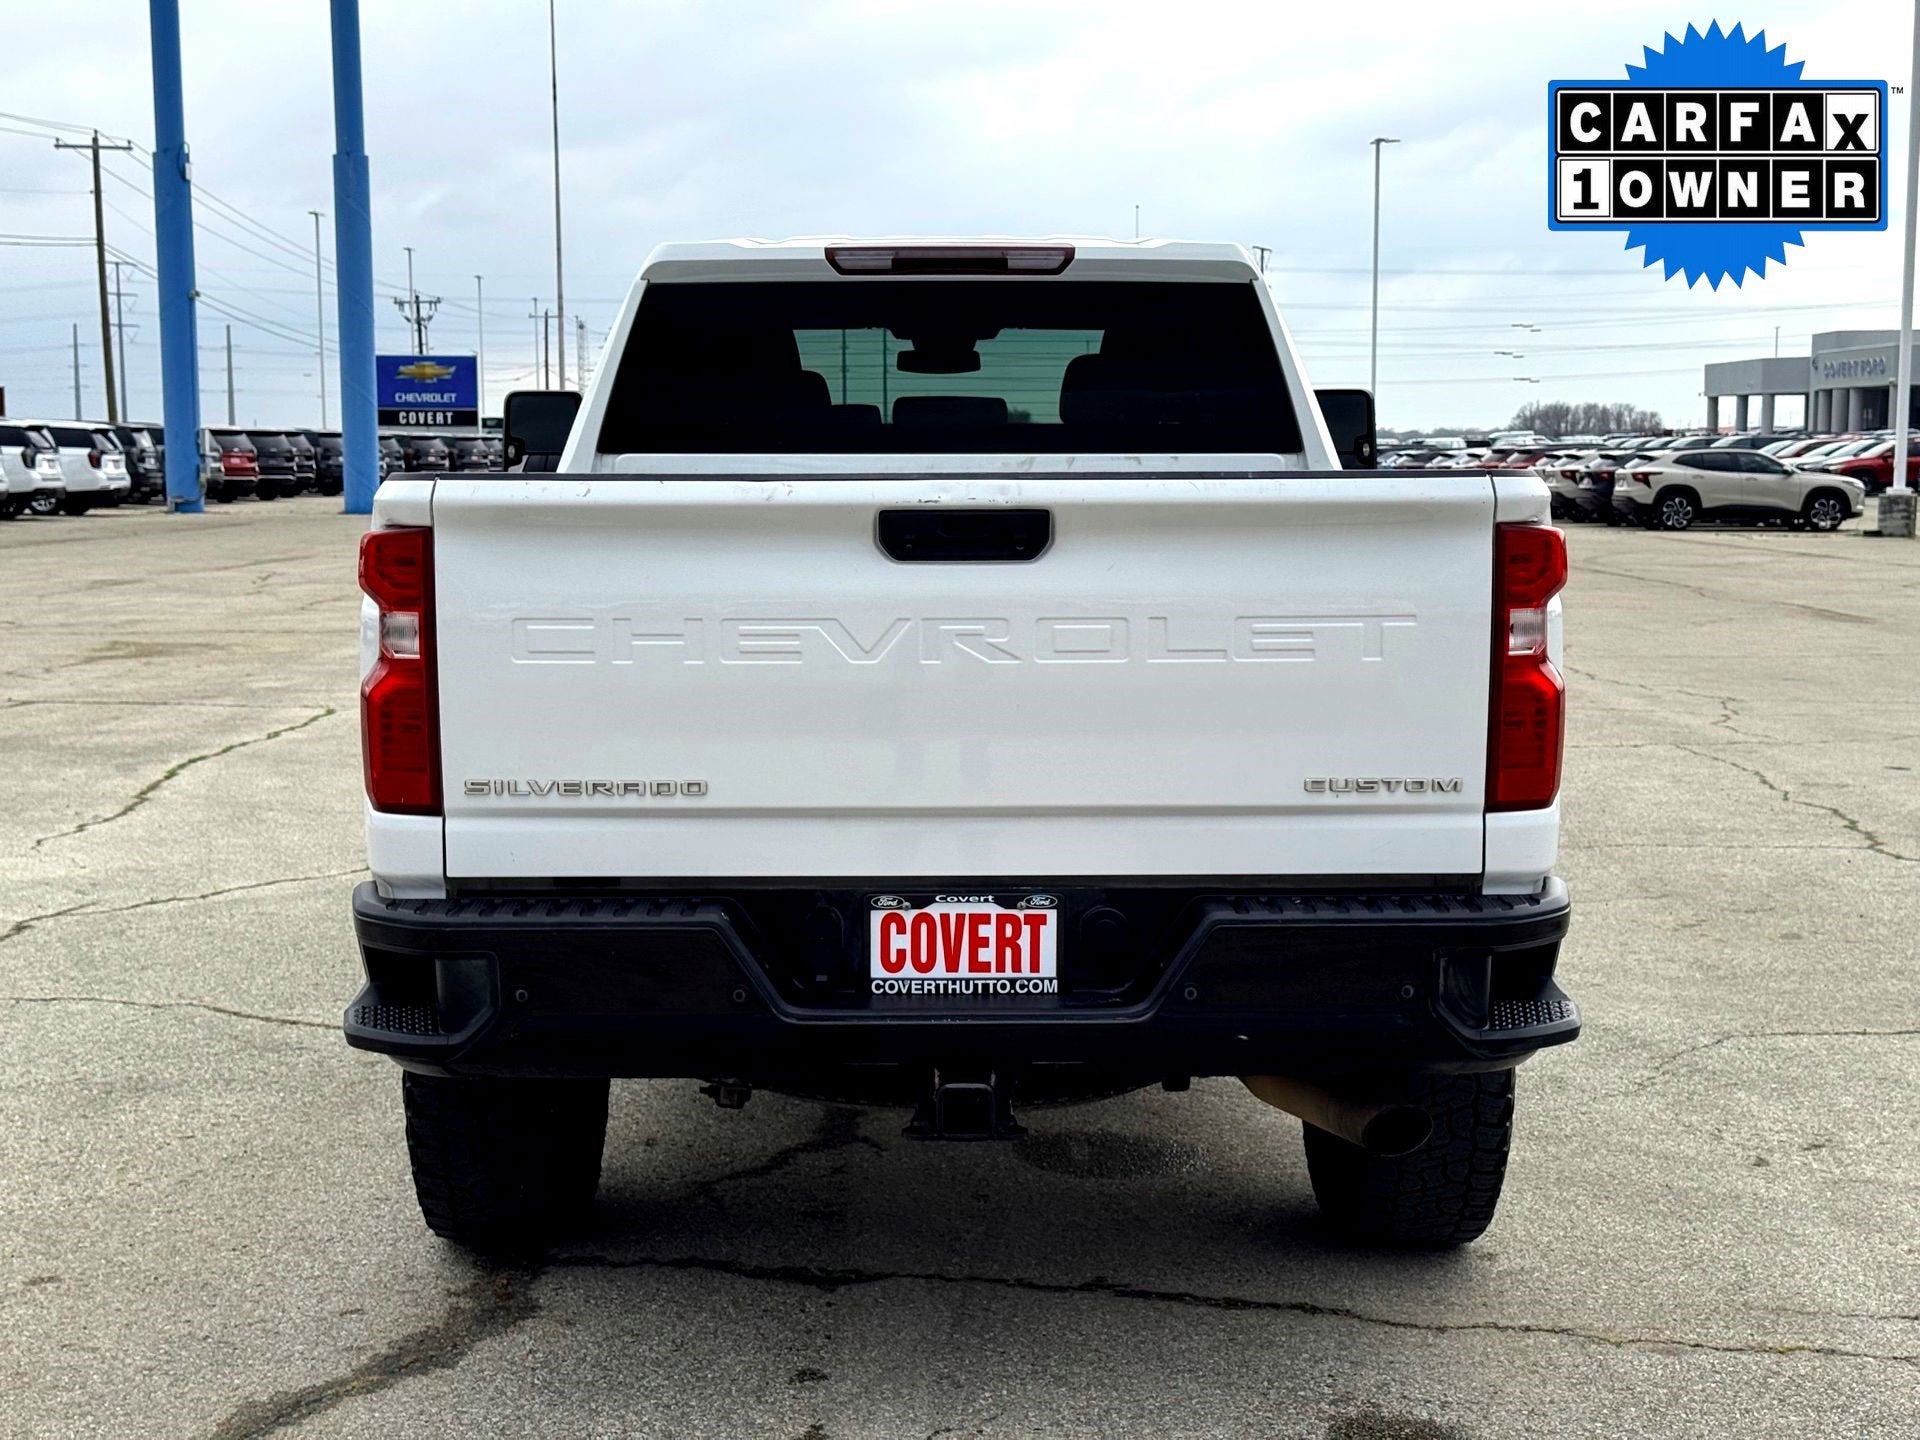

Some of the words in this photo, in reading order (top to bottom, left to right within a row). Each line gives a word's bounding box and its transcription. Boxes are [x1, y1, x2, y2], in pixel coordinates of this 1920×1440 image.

[394, 392, 457, 403] CHEVROLET
[399, 411, 453, 424] COVERT
[510, 614, 1418, 665] CHEVROLET
[463, 779, 708, 796] SILVERADO
[1304, 777, 1463, 793] CUSTOM
[876, 897, 899, 907] Ford
[935, 894, 995, 903] Covert
[1029, 895, 1051, 906] Ford
[880, 911, 1048, 974] COVERT
[871, 979, 1059, 994] COVERTHUTTO.COM
